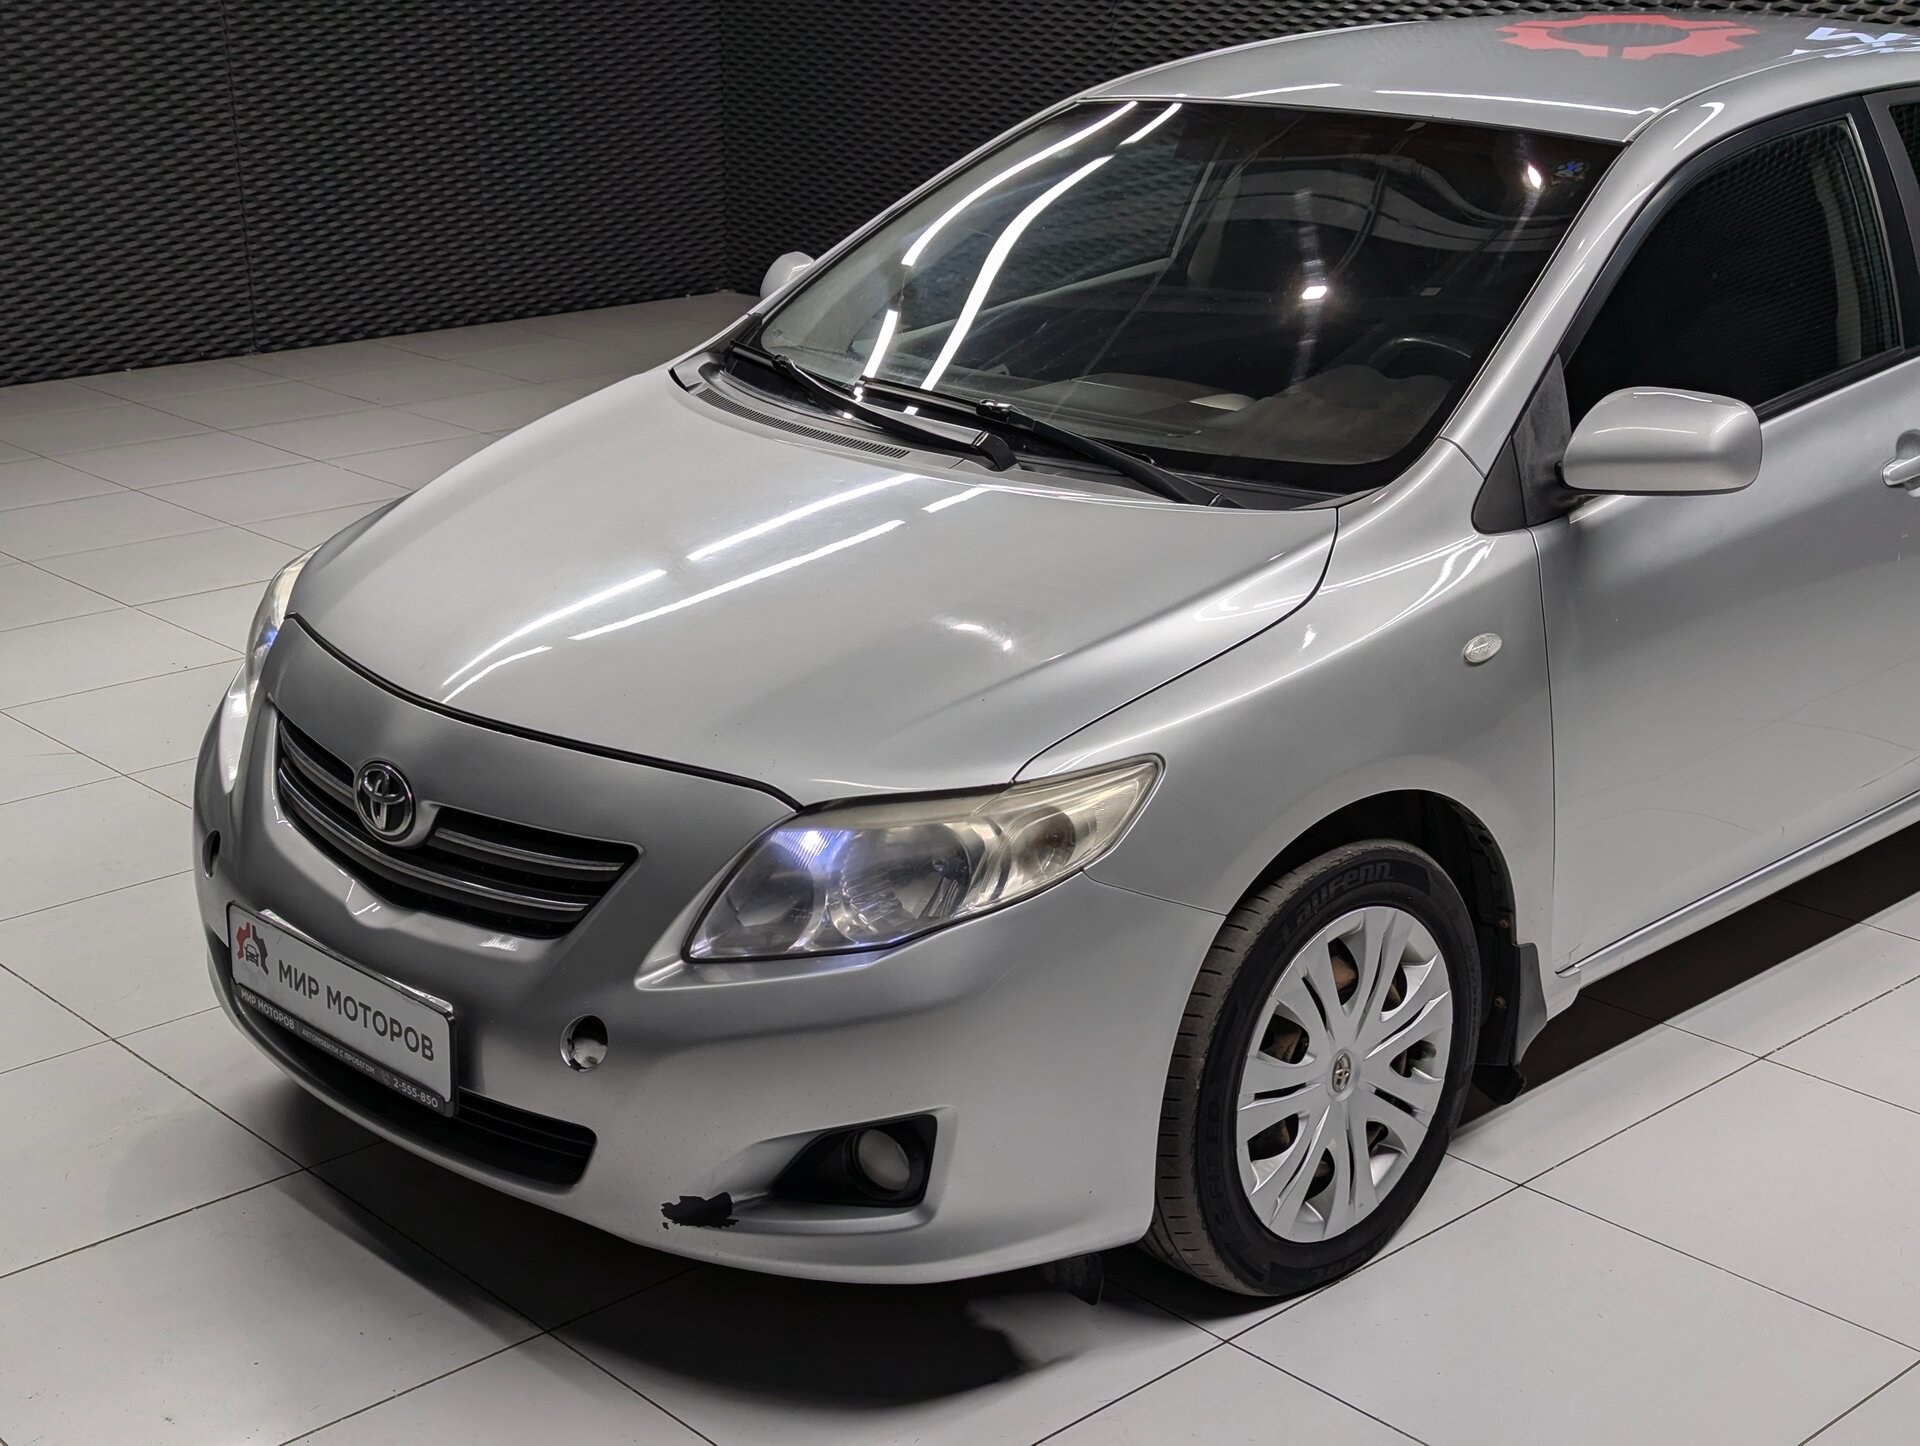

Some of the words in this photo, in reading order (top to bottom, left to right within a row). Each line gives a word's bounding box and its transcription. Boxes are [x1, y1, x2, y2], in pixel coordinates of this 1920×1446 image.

[241, 989, 256, 1004] МИР
[258, 1000, 295, 1029] МОТОРОВ
[344, 1053, 375, 1073] ПРОБЕГОМ
[393, 1078, 438, 1108] 2-555-850
[278, 959, 319, 999] МИР
[326, 985, 435, 1061] МОТОРОВ
